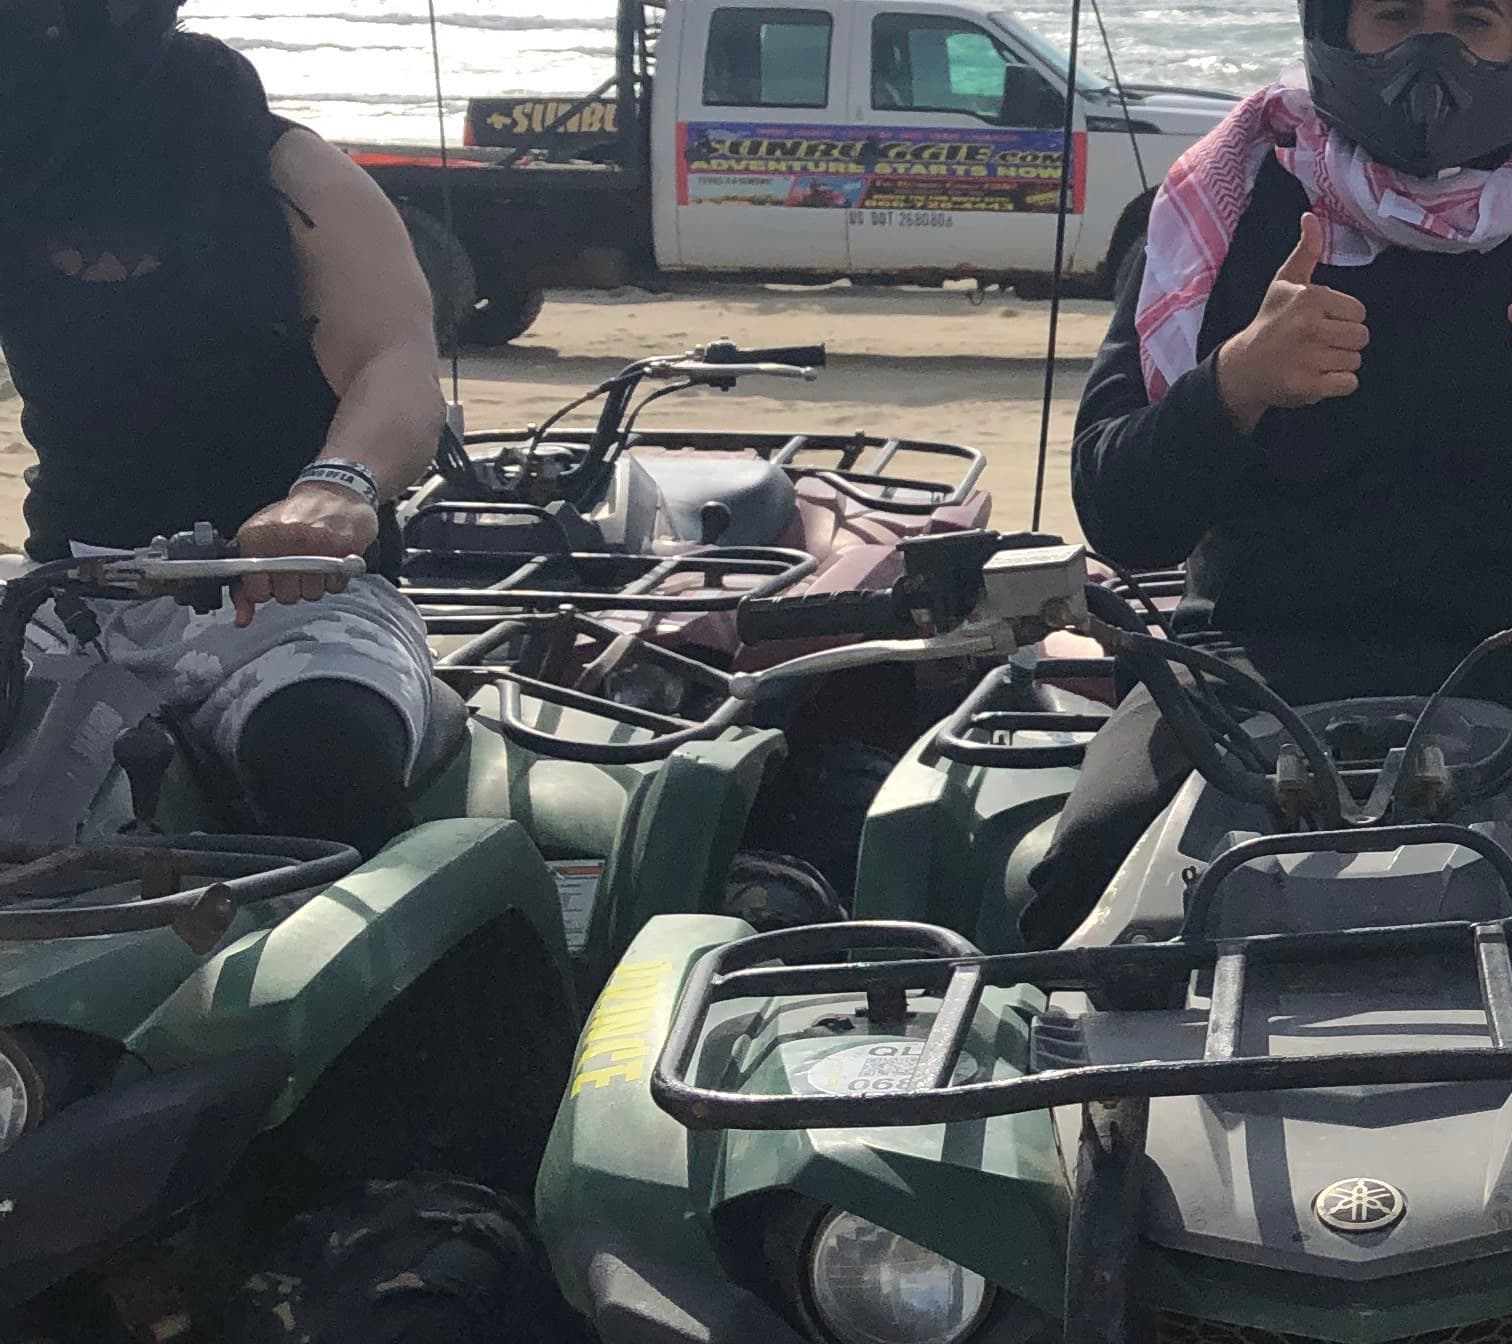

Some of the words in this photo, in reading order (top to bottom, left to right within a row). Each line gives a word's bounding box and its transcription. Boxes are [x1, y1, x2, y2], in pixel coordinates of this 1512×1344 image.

[690, 158, 866, 174] ADVENTURE
[874, 162, 988, 176] STARTS
[996, 165, 1064, 179] NOW
